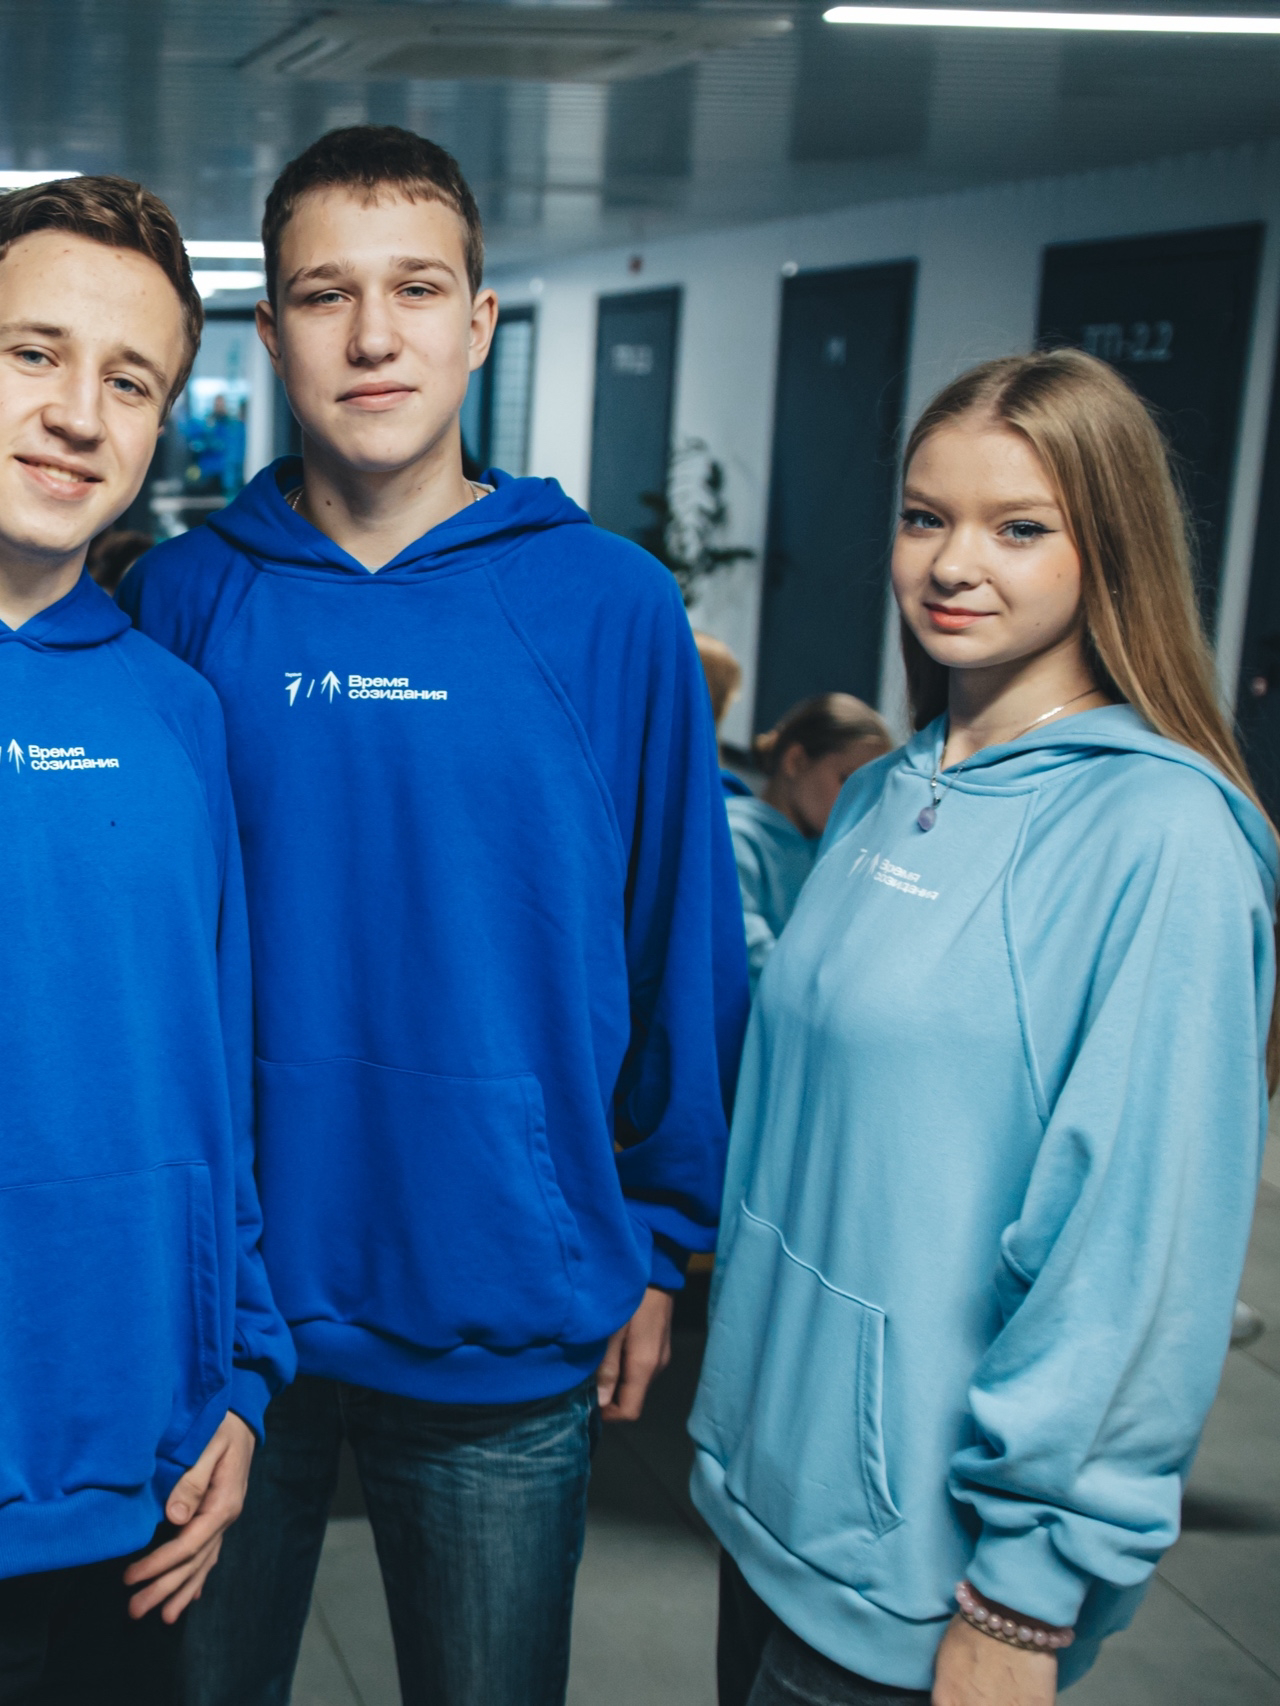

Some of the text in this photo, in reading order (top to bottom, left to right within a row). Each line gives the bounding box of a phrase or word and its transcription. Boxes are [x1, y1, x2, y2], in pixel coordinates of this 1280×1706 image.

[348, 675, 409, 688] Время
[348, 688, 448, 701] созидания
[28, 744, 85, 761] Время
[31, 758, 120, 771] созидания
